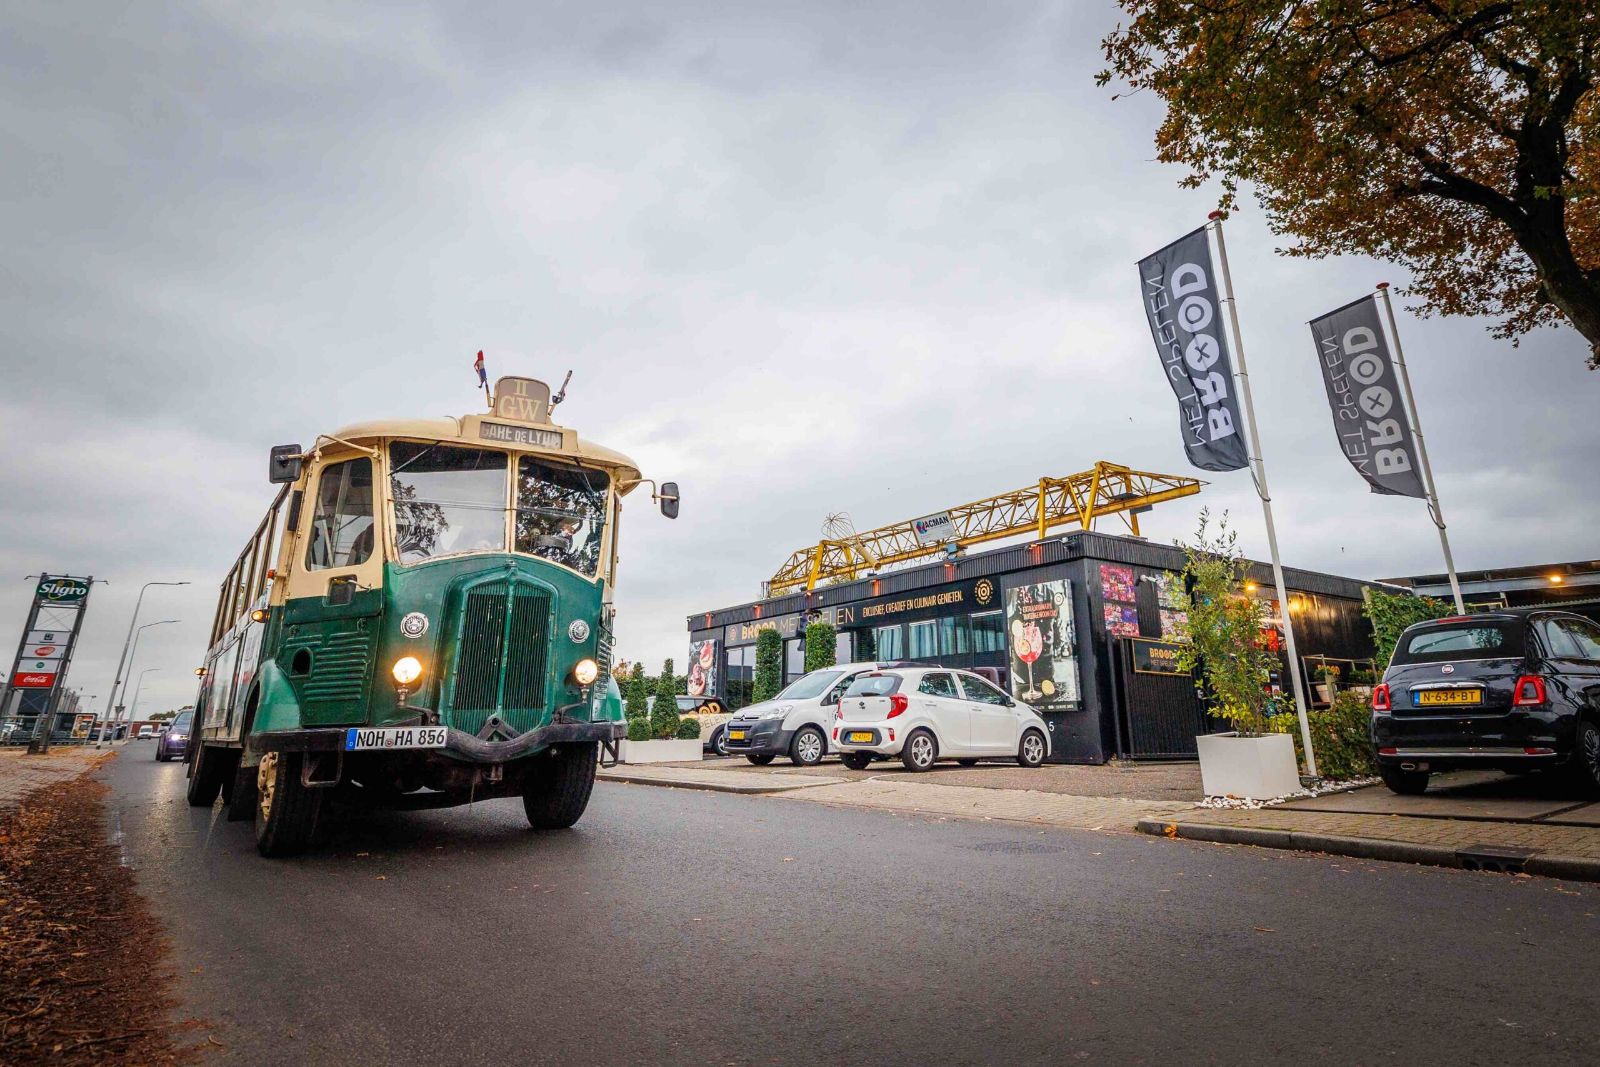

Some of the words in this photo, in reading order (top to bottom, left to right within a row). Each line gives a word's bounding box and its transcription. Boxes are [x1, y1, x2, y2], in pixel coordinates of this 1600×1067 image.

[499, 395, 542, 421] GW
[514, 430, 527, 442] DE
[39, 582, 87, 597] Sligro
[906, 599, 914, 610] EN
[780, 616, 803, 633] MET
[1423, 691, 1476, 702] N-634-BT
[700, 714, 728, 729] PELEN
[1048, 721, 1055, 731] 5
[356, 730, 385, 747] NOH
[394, 731, 413, 746] HA
[418, 729, 445, 745] 856
